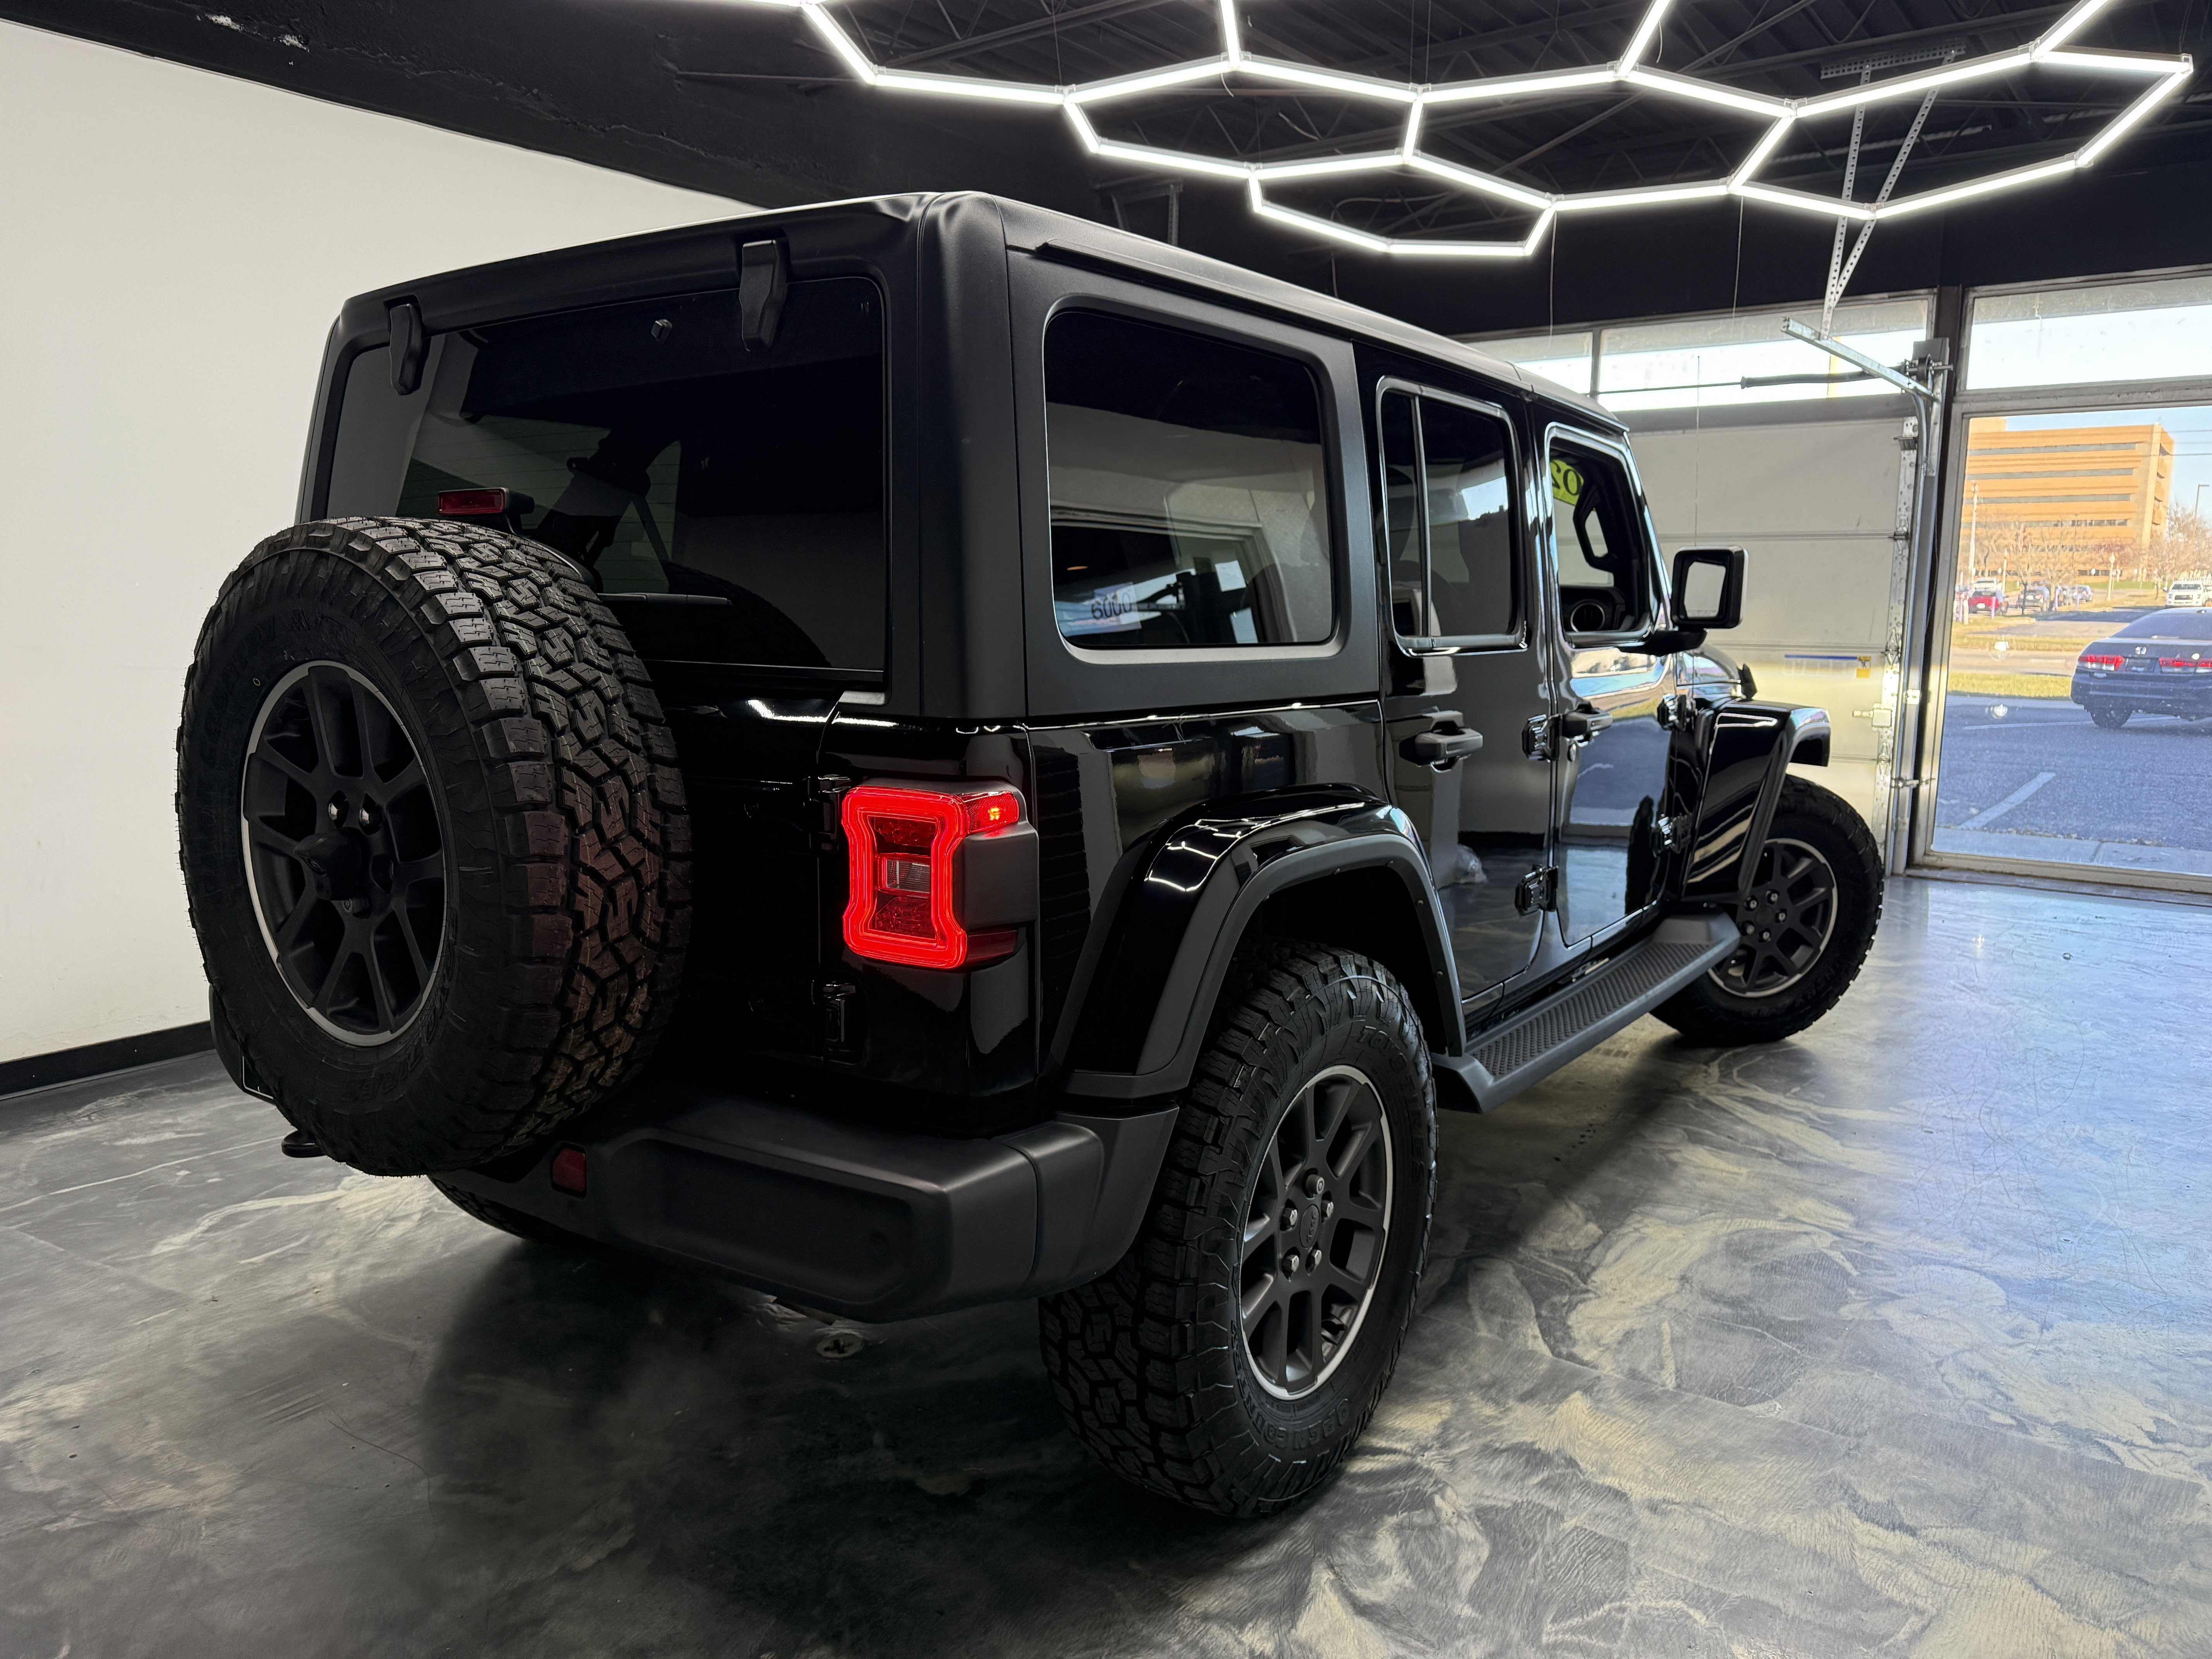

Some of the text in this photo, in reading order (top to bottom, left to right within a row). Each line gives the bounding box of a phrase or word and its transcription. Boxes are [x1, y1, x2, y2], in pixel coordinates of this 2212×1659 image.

[1092, 592, 1132, 619] 6000
[1356, 1025, 1408, 1073] TOYO
[1400, 1073, 1425, 1187] TIRES
